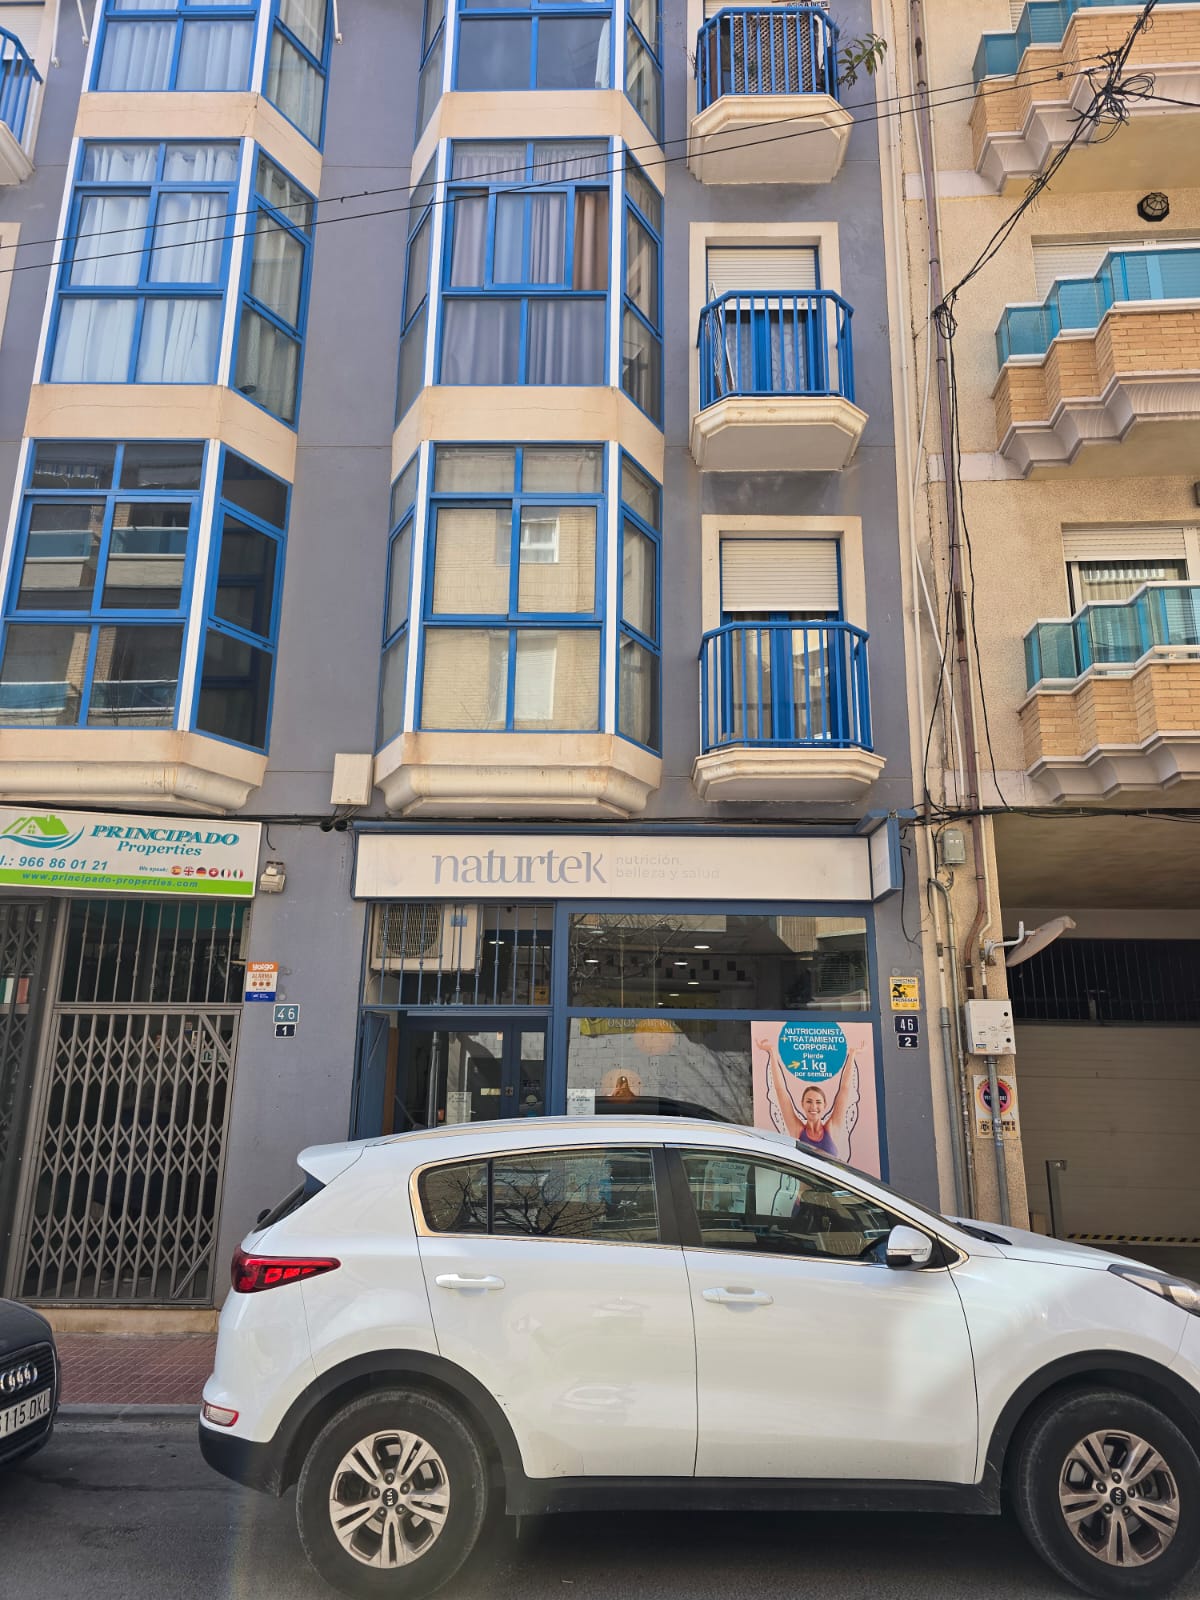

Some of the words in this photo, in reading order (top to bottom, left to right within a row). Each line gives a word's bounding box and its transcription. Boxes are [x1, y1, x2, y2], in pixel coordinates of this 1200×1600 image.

[89, 824, 240, 846] PRINCIPADO
[117, 840, 202, 856] Properties
[0, 855, 15, 867] l.:
[18, 856, 45, 868] 966
[49, 858, 65, 869] 86
[70, 859, 87, 870] 01
[92, 860, 108, 871] 21
[432, 849, 608, 885] naturtek
[22, 872, 198, 889] www.principado-properties.com
[670, 869, 679, 881] y
[277, 1007, 296, 1020] 46
[282, 1025, 288, 1036] 1
[900, 1018, 914, 1031] 46
[793, 1043, 838, 1051] CORPORAL
[904, 1036, 912, 1047] 2
[802, 1052, 824, 1060] Pierde
[801, 1059, 809, 1071] 1
[811, 1059, 827, 1073] kg
[29, 1393, 48, 1420] DXL
